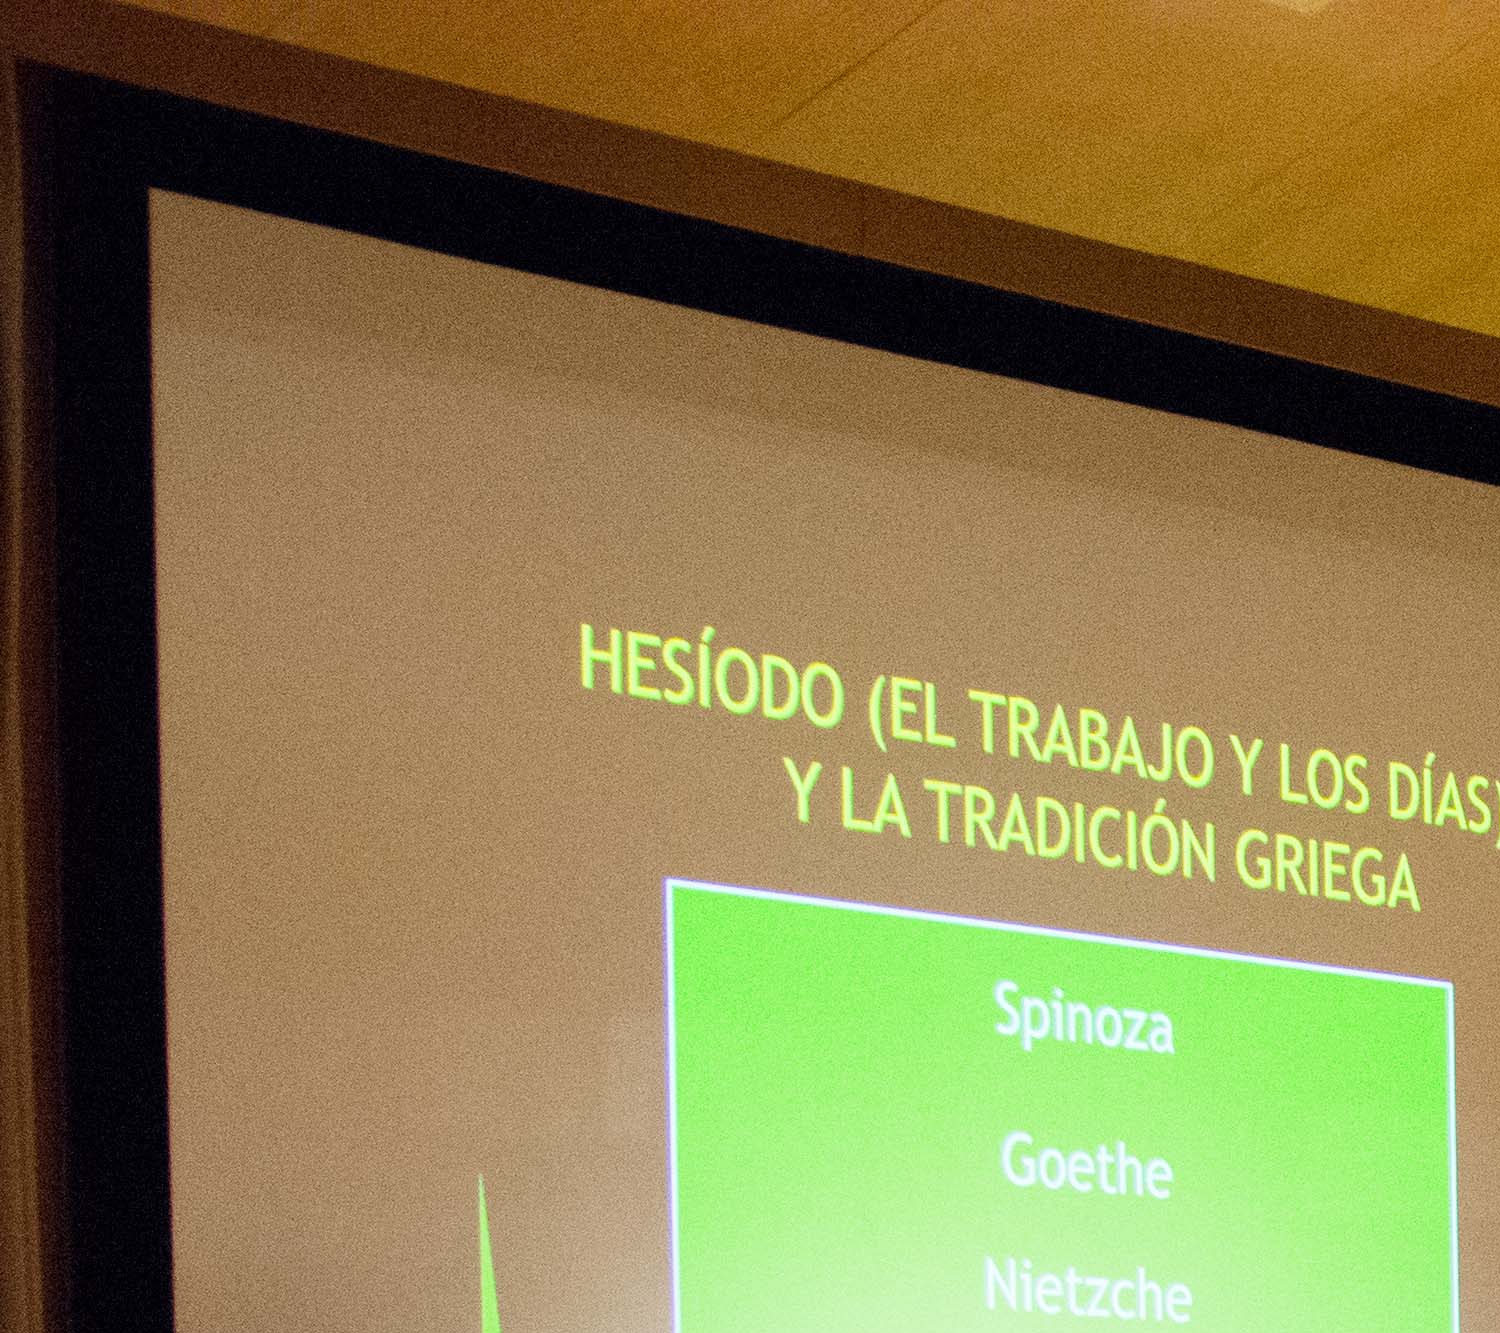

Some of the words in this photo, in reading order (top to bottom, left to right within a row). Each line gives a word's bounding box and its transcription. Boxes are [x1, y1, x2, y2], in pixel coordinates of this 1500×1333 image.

[580, 623, 845, 730] HESÍODO
[868, 674, 957, 752] (EL
[967, 689, 1215, 789] TRABAJO
[1229, 734, 1264, 796] Y
[1280, 742, 1371, 816] LOS
[783, 756, 823, 824] Y
[840, 765, 912, 839] LA
[922, 778, 1217, 882] TRADICIÓN
[1234, 828, 1423, 914] GRIEGA
[993, 980, 1175, 1054] Spinoza
[999, 1130, 1174, 1202] Goethe
[983, 1257, 1194, 1324] Nietzche
